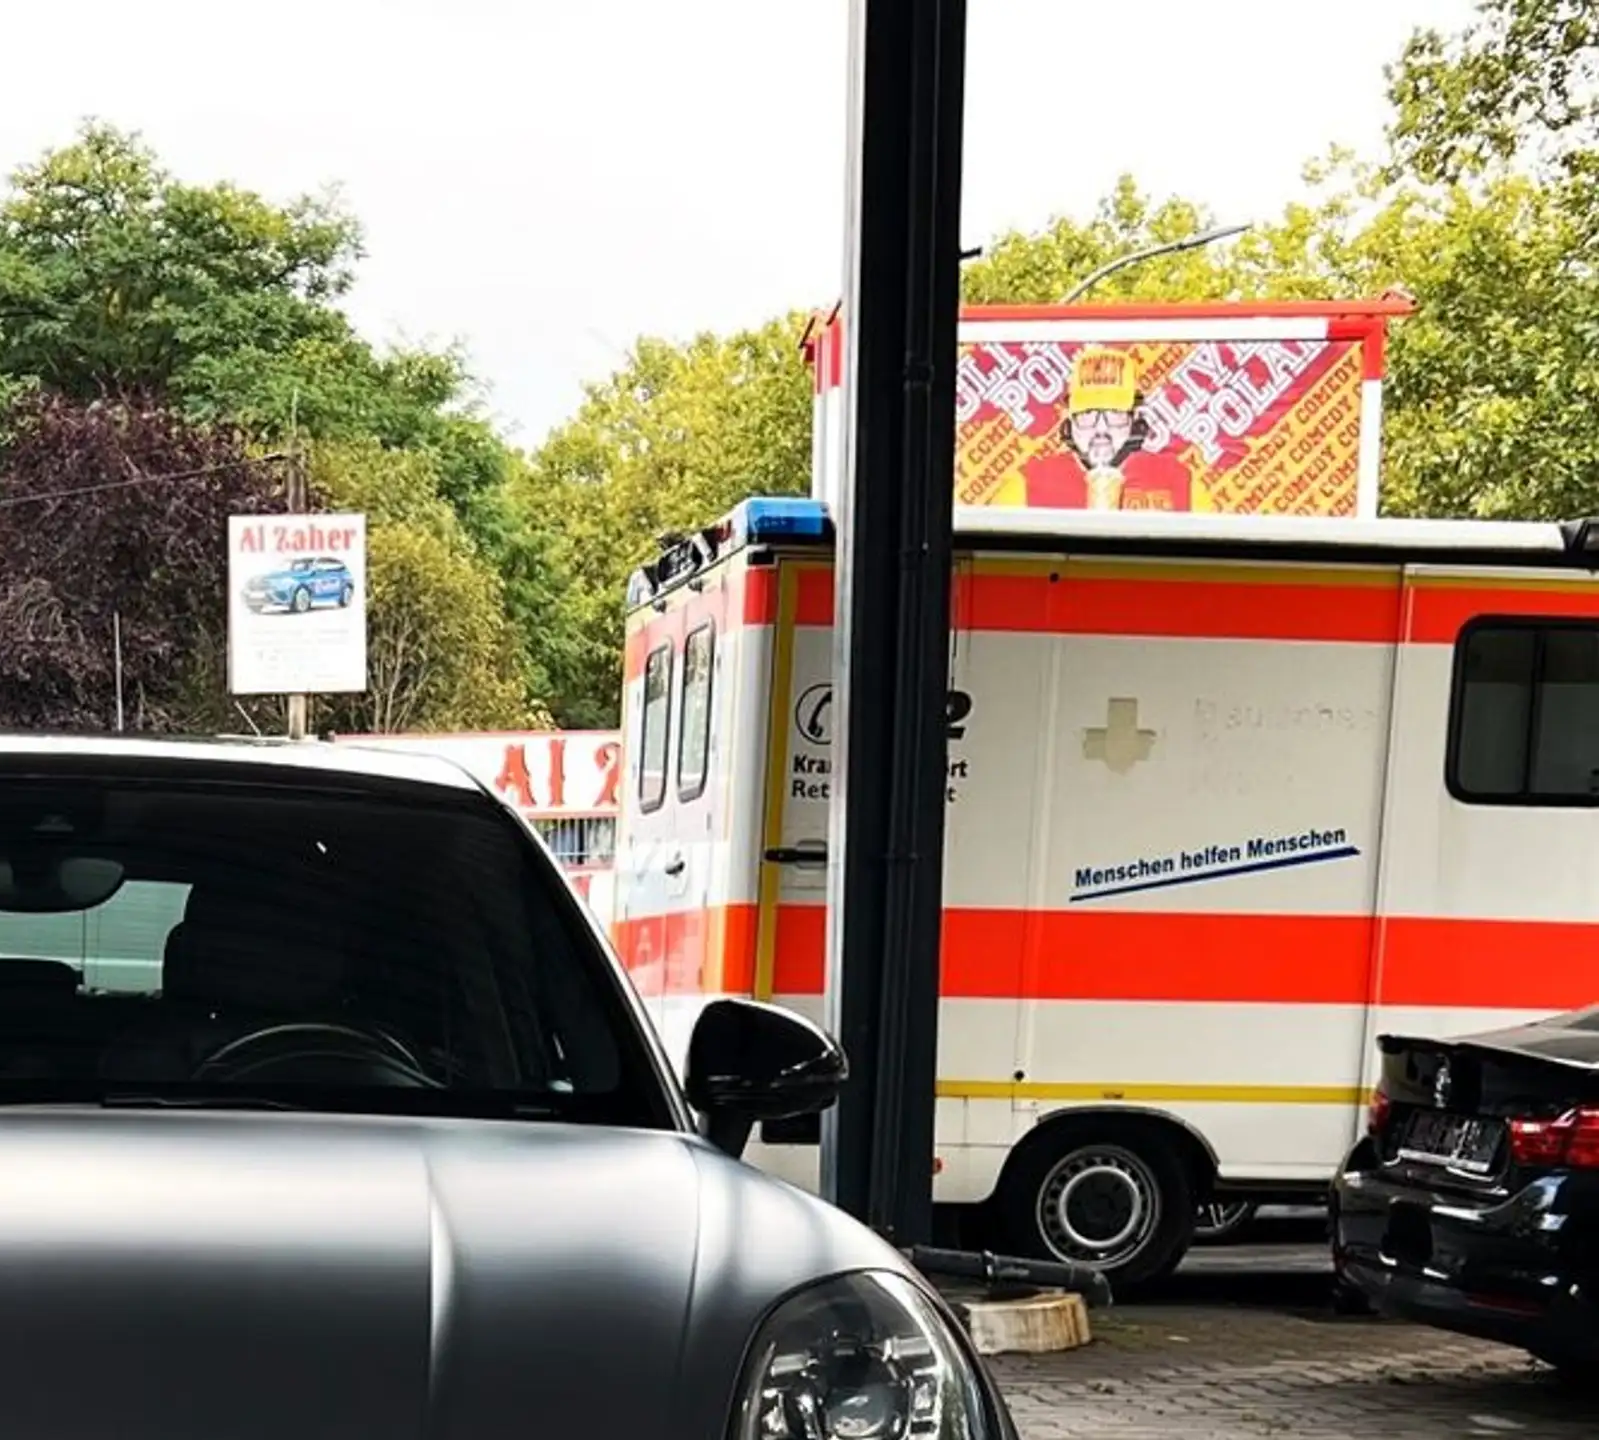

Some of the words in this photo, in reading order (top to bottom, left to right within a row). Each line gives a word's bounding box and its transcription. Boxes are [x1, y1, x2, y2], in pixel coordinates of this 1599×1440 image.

[1294, 357, 1359, 426] COMEDY
[1288, 396, 1354, 465] COMEDY
[273, 524, 357, 554] Zaher
[1075, 860, 1175, 888] Menschen
[1180, 846, 1241, 869] helfen
[1246, 828, 1347, 858] Menschen
